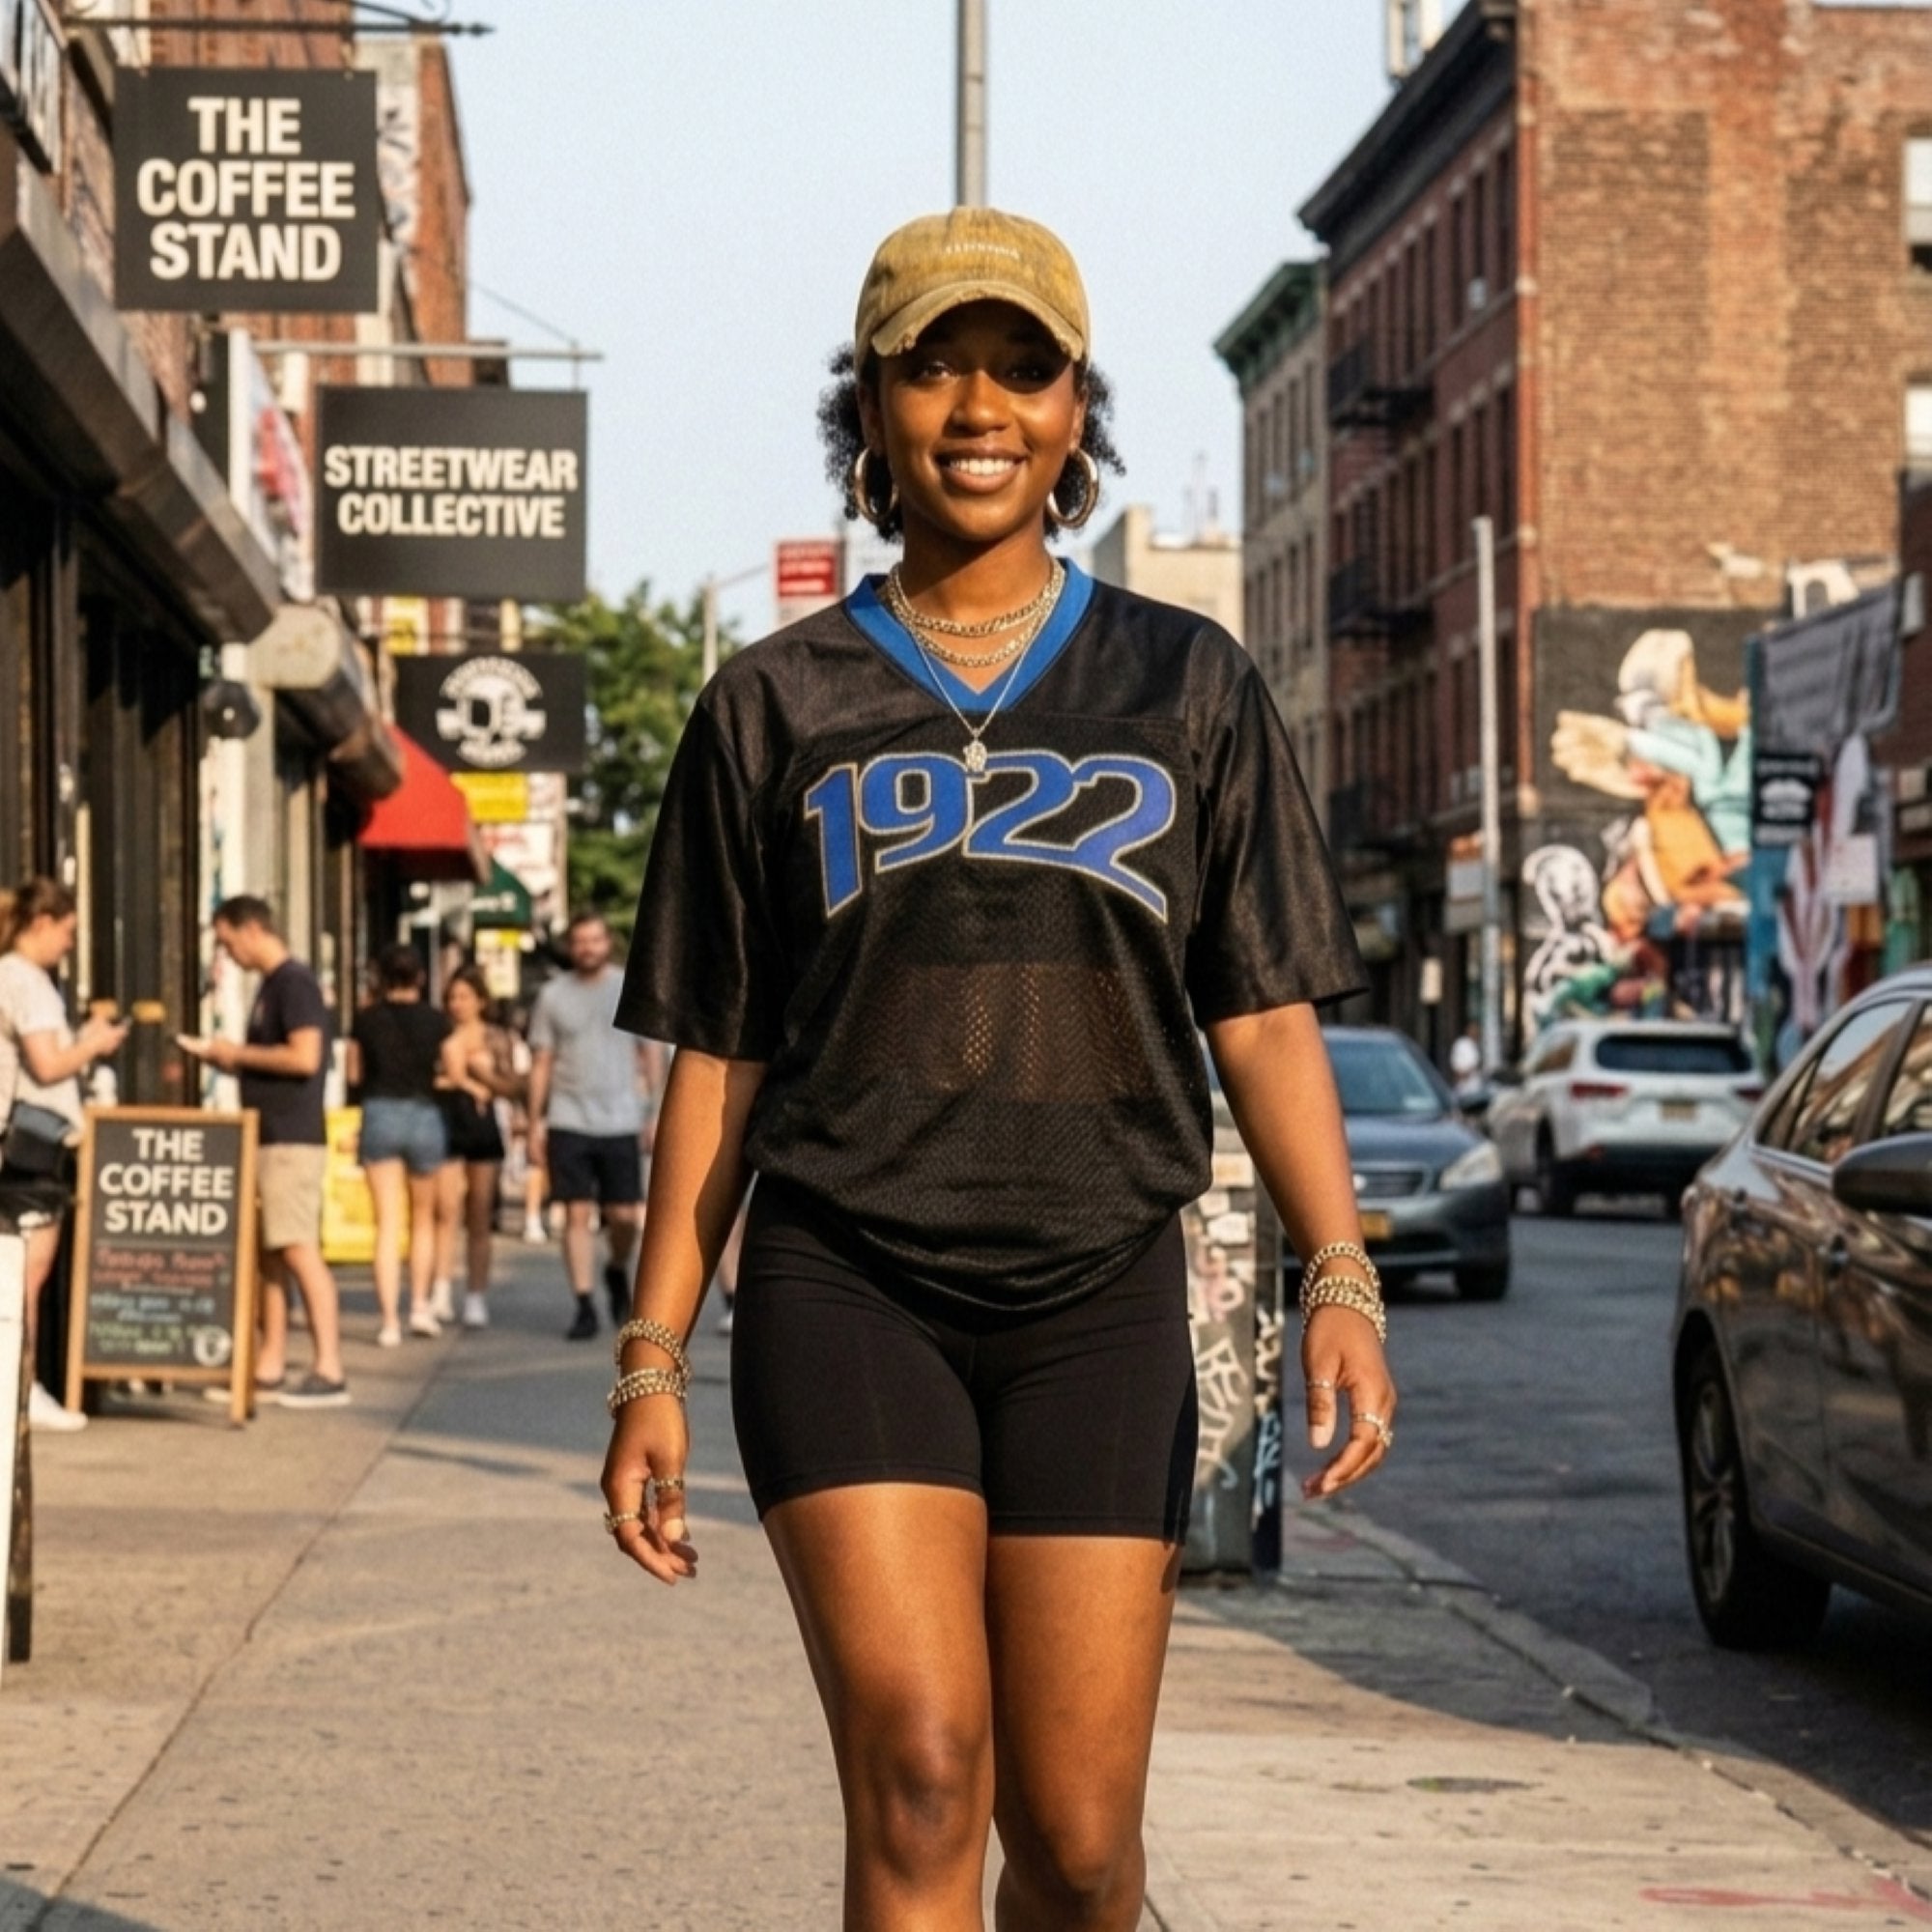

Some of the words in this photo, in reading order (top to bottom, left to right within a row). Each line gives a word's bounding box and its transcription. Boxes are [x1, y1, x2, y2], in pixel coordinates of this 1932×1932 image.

[188, 98, 300, 155] THE
[137, 159, 355, 218] COFFEE
[151, 222, 341, 281] STAND
[325, 446, 578, 492] STREETWEAR
[338, 494, 565, 538] COLLECTIVE
[804, 749, 1176, 923] 1922
[132, 1128, 204, 1162] THE
[99, 1163, 234, 1199] COFFEE
[105, 1200, 228, 1236] STAND
